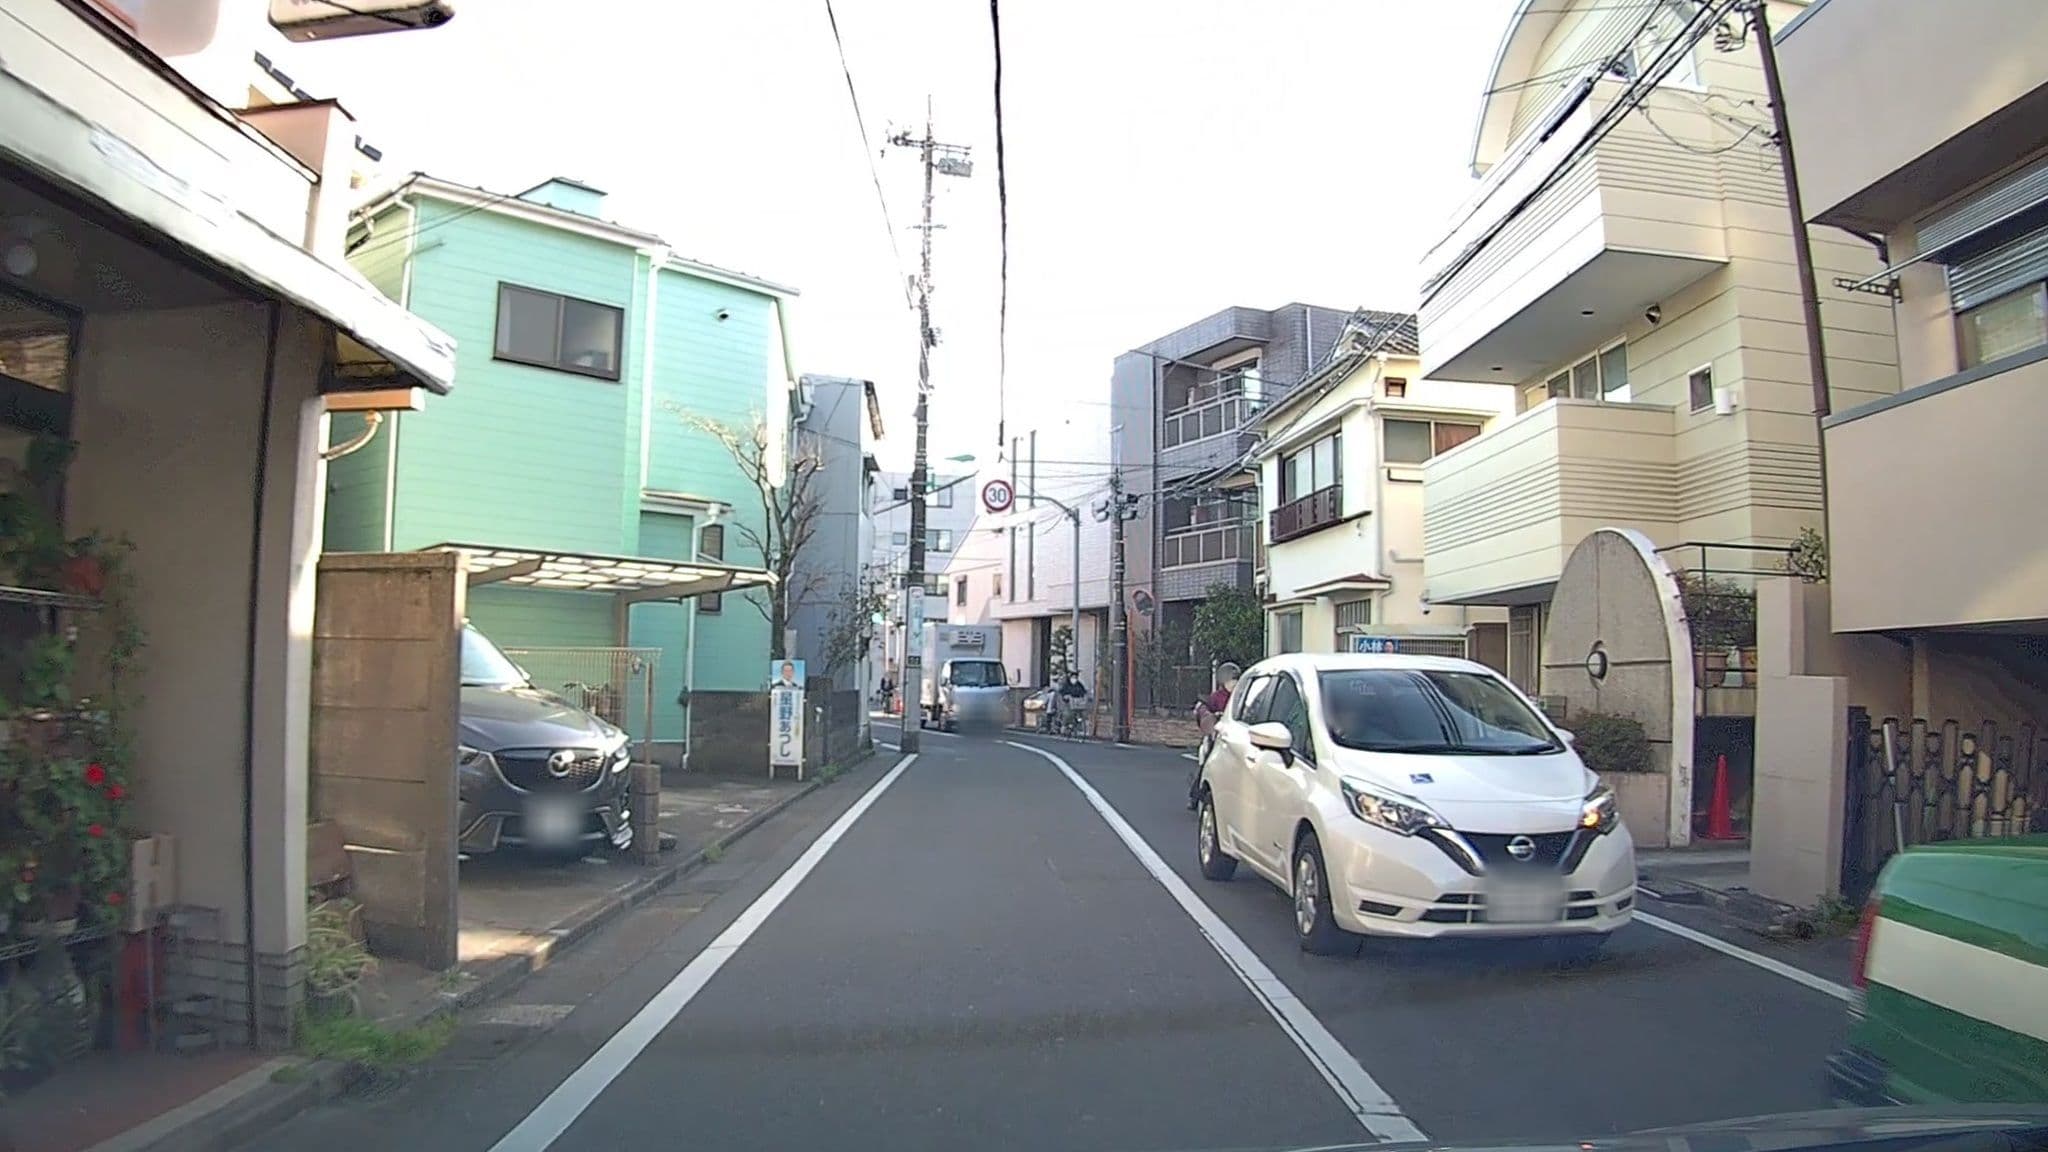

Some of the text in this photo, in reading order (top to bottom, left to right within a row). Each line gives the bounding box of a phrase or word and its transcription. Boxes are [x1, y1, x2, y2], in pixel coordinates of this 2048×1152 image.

[988, 487, 1007, 504] 30
[779, 691, 793, 757] 星野あつし
